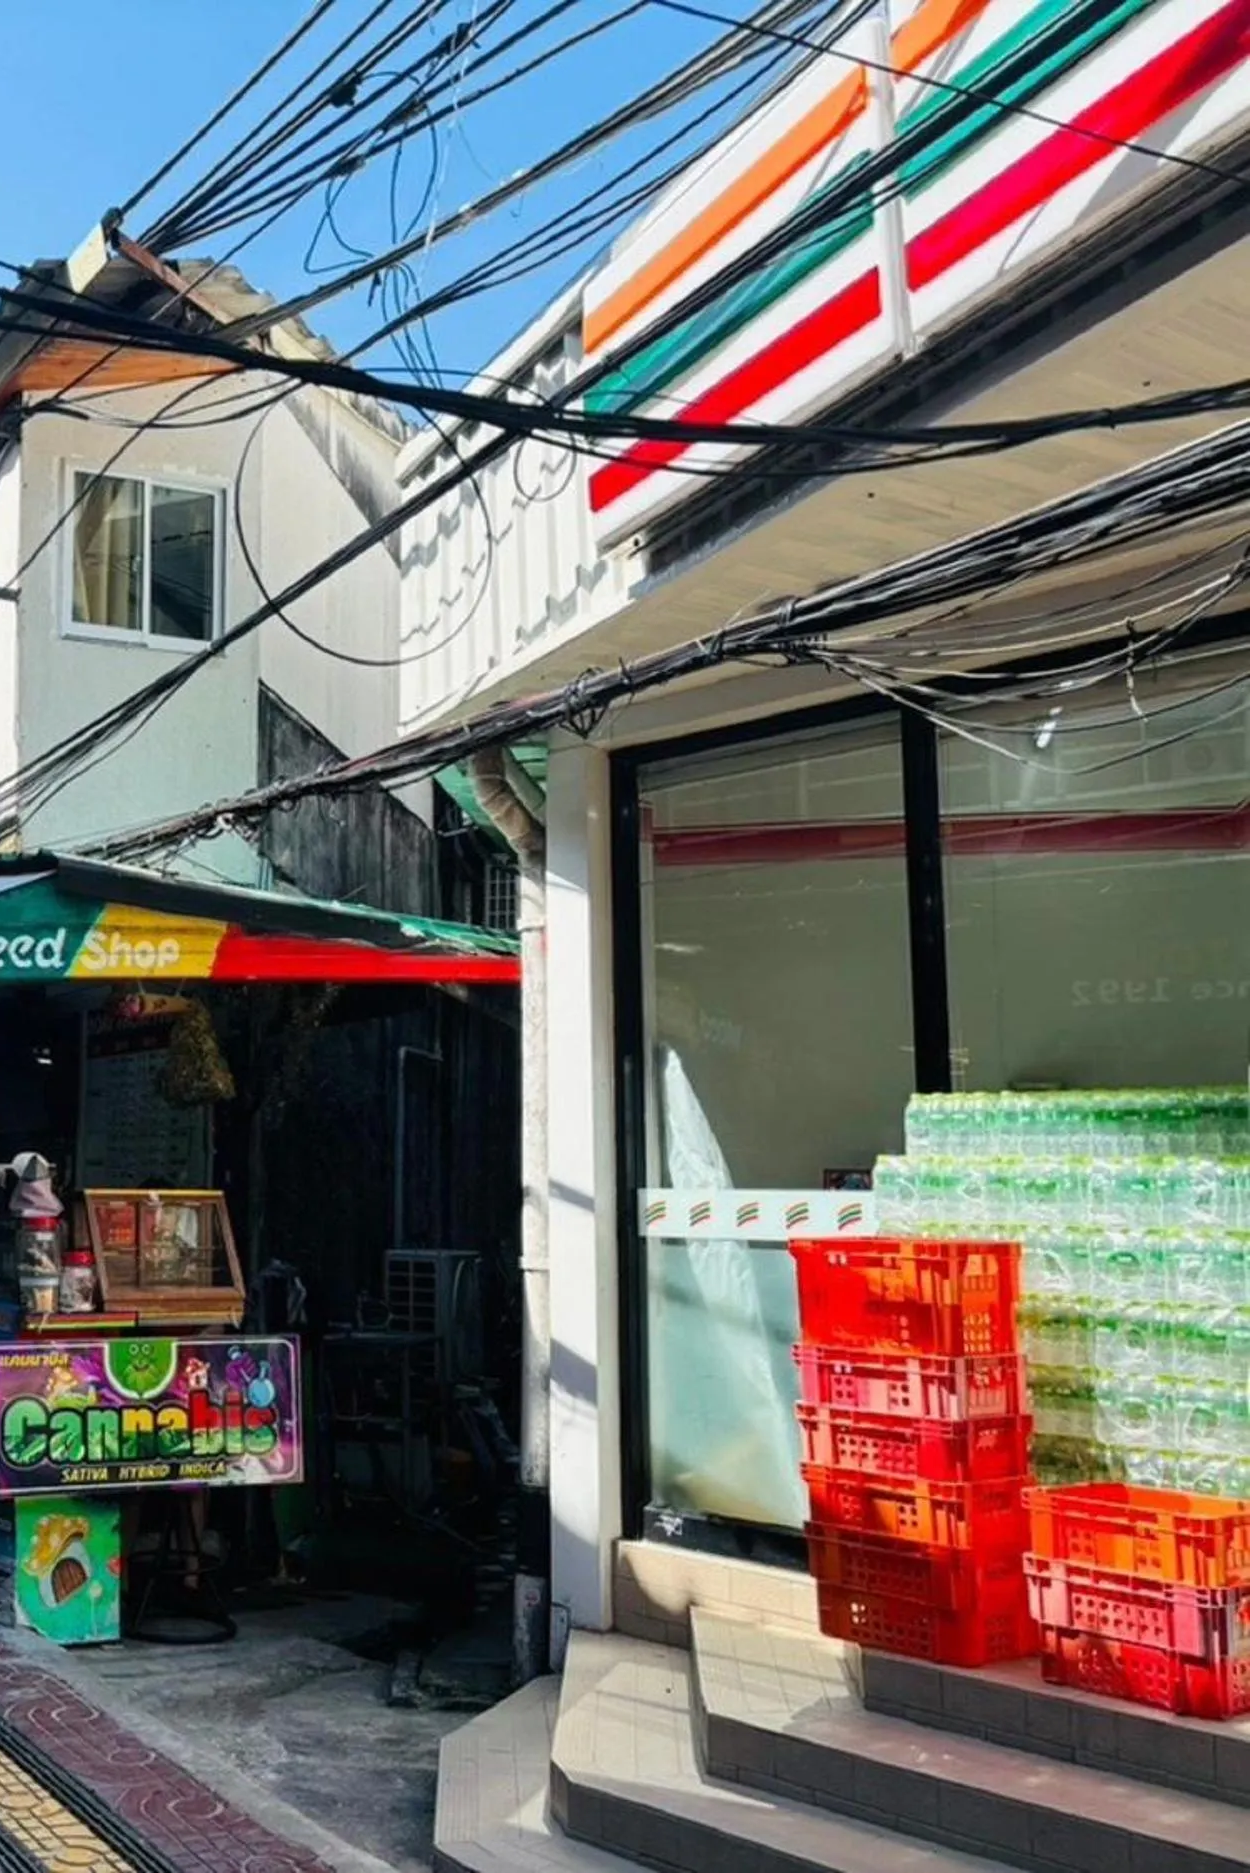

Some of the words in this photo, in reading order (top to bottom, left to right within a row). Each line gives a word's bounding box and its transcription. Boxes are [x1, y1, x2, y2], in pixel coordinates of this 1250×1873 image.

[79, 931, 181, 970] Shop
[0, 1388, 280, 1467] Cannabis
[61, 1467, 108, 1483] SATIVA
[118, 1465, 170, 1481] HYBRID
[178, 1462, 226, 1478] INDICA
